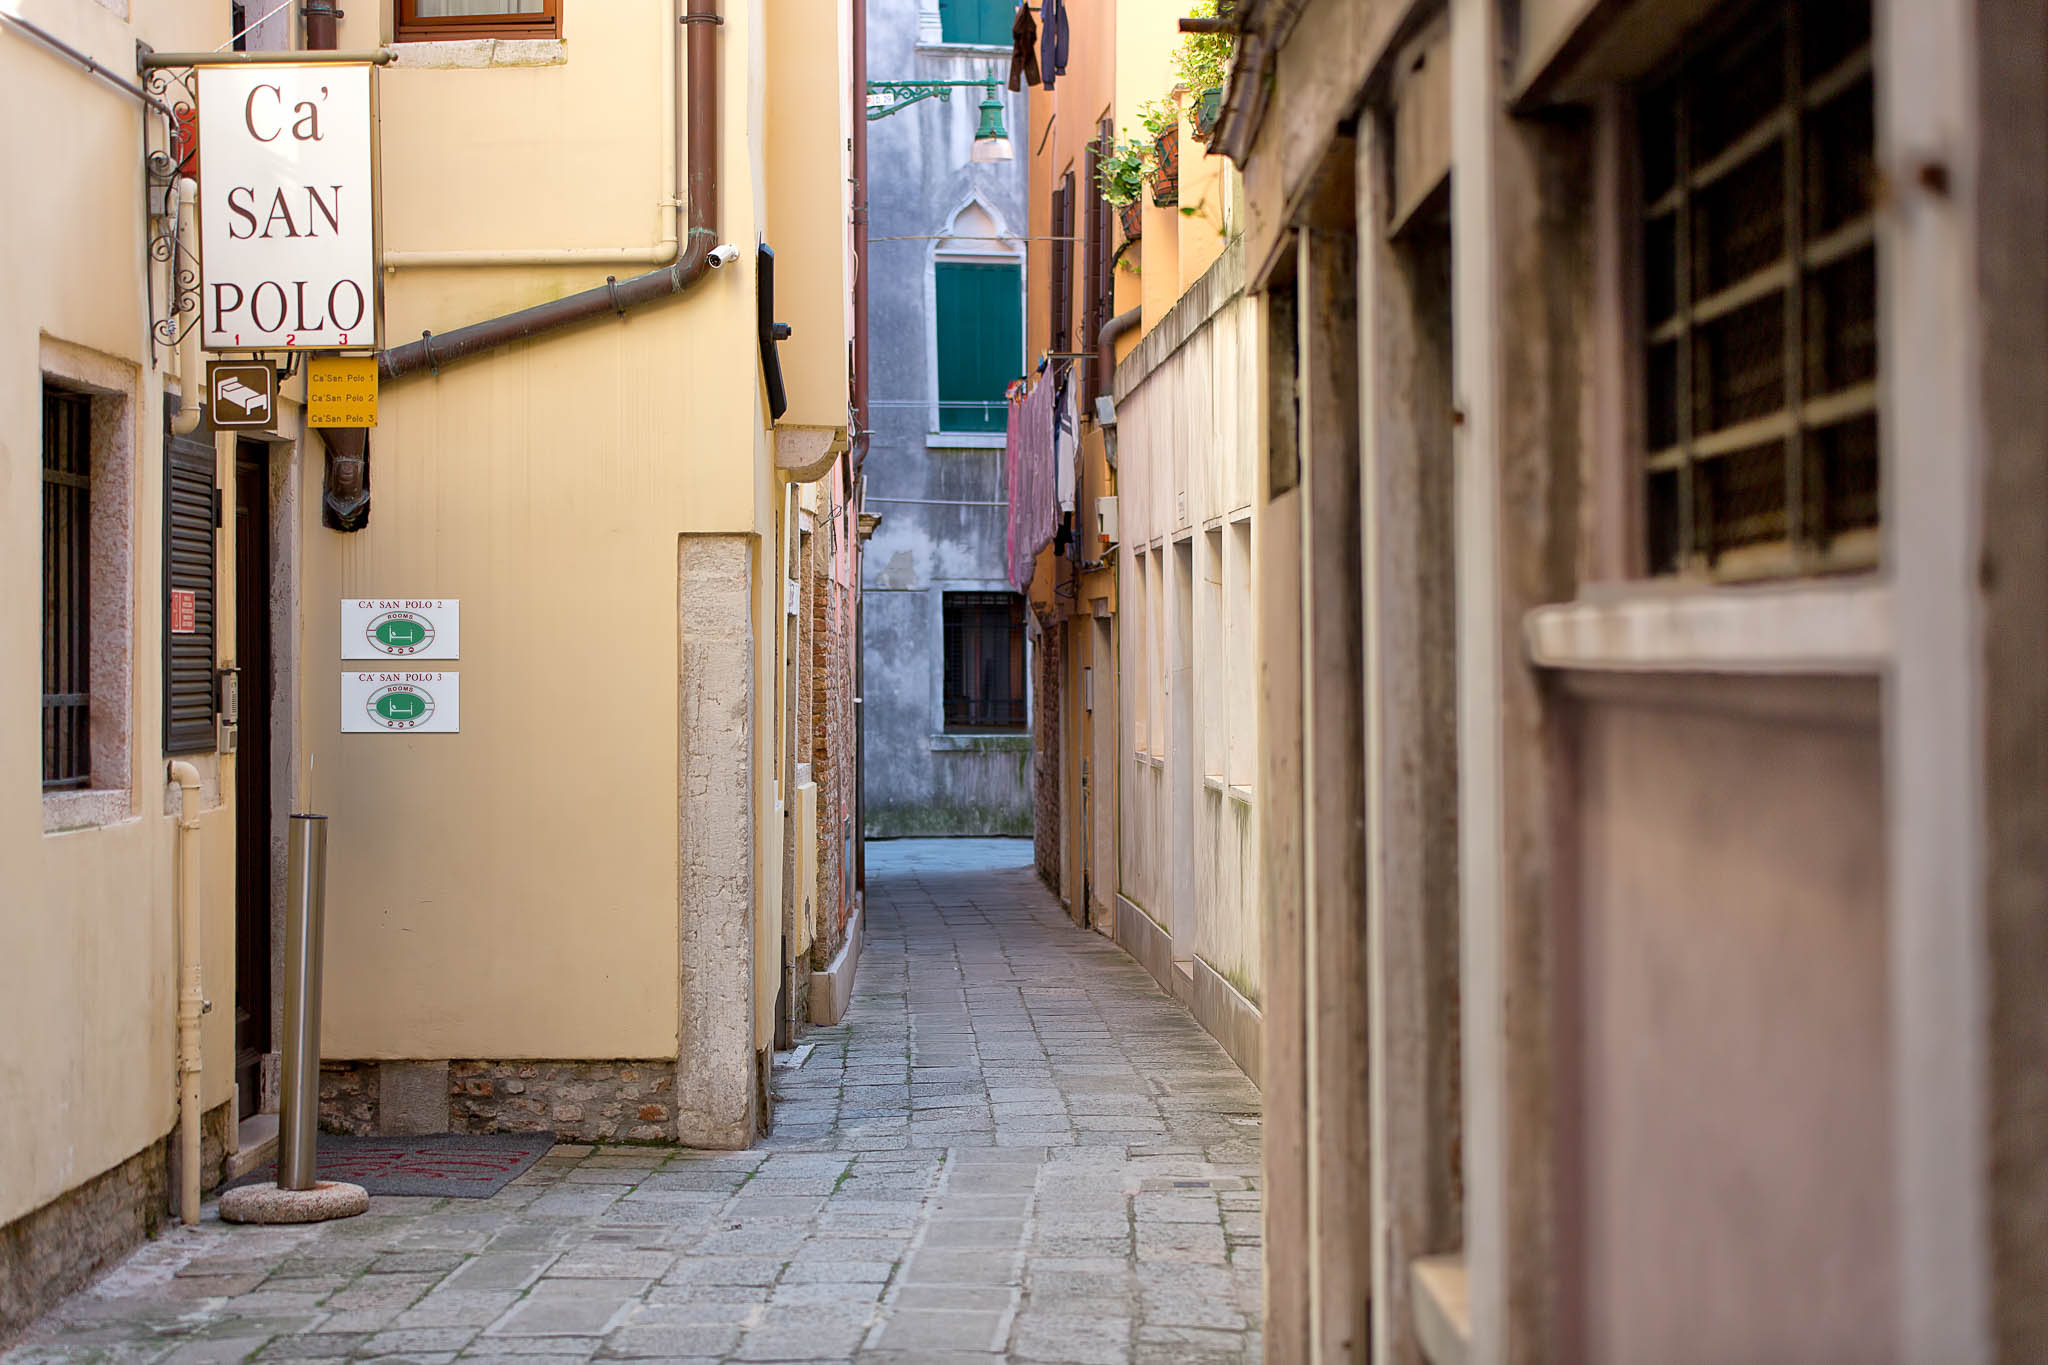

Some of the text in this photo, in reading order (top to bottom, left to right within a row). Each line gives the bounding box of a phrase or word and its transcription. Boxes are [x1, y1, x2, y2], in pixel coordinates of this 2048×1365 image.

[245, 84, 328, 142] Ca'
[228, 185, 343, 240] SAN
[210, 279, 365, 333] POLO
[234, 333, 348, 346] 1 2 3
[347, 374, 365, 382] Polo
[369, 374, 374, 382] 1
[346, 393, 364, 402] Polo
[368, 393, 375, 402] 2
[345, 414, 364, 422] Polo
[368, 414, 375, 422] 3
[358, 600, 443, 609] CA' SAN POLO 2
[358, 673, 442, 682] CA' SAN POLO 3
